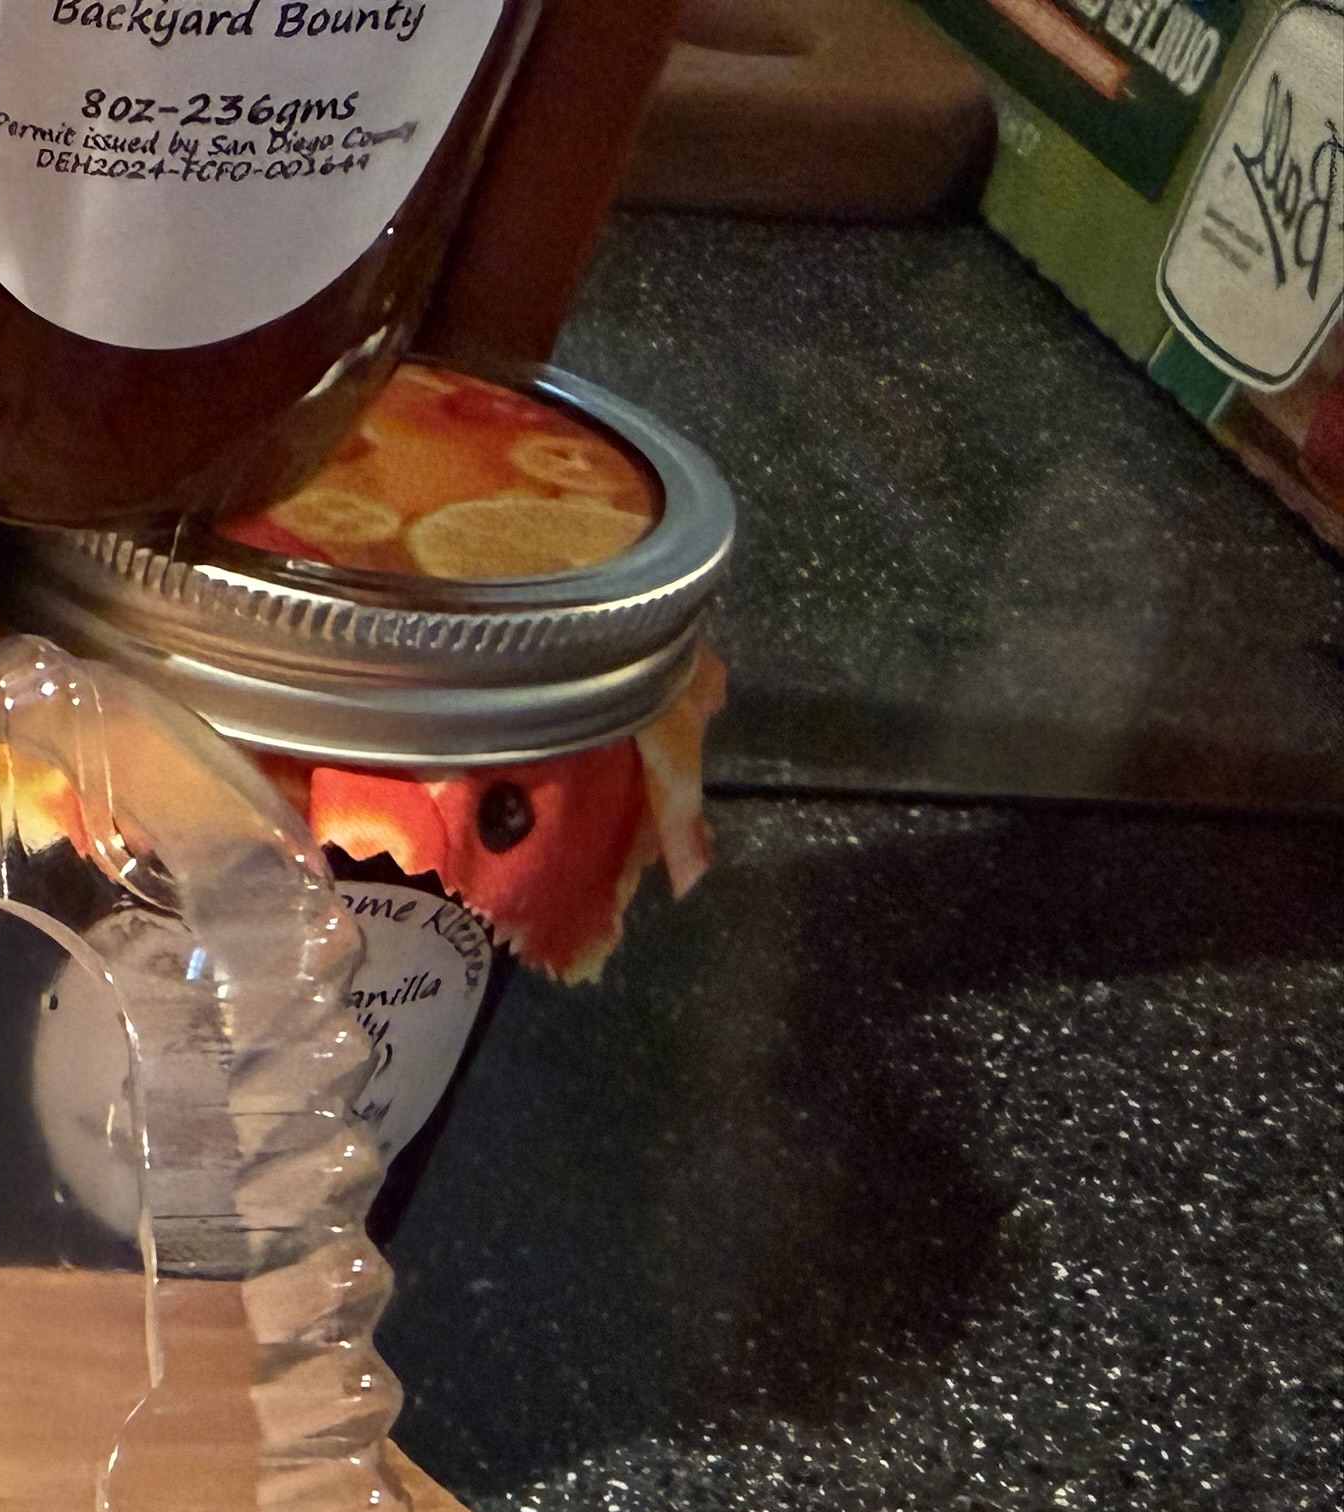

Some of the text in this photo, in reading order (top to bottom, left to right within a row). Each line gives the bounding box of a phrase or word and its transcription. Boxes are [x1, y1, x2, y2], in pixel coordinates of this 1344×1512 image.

[52, 0, 426, 47] Backyard Bounty
[81, 88, 359, 131] 8oz-236gms
[169, 130, 199, 160] by
[208, 134, 256, 156] San
[351, 971, 442, 1009] anilla
